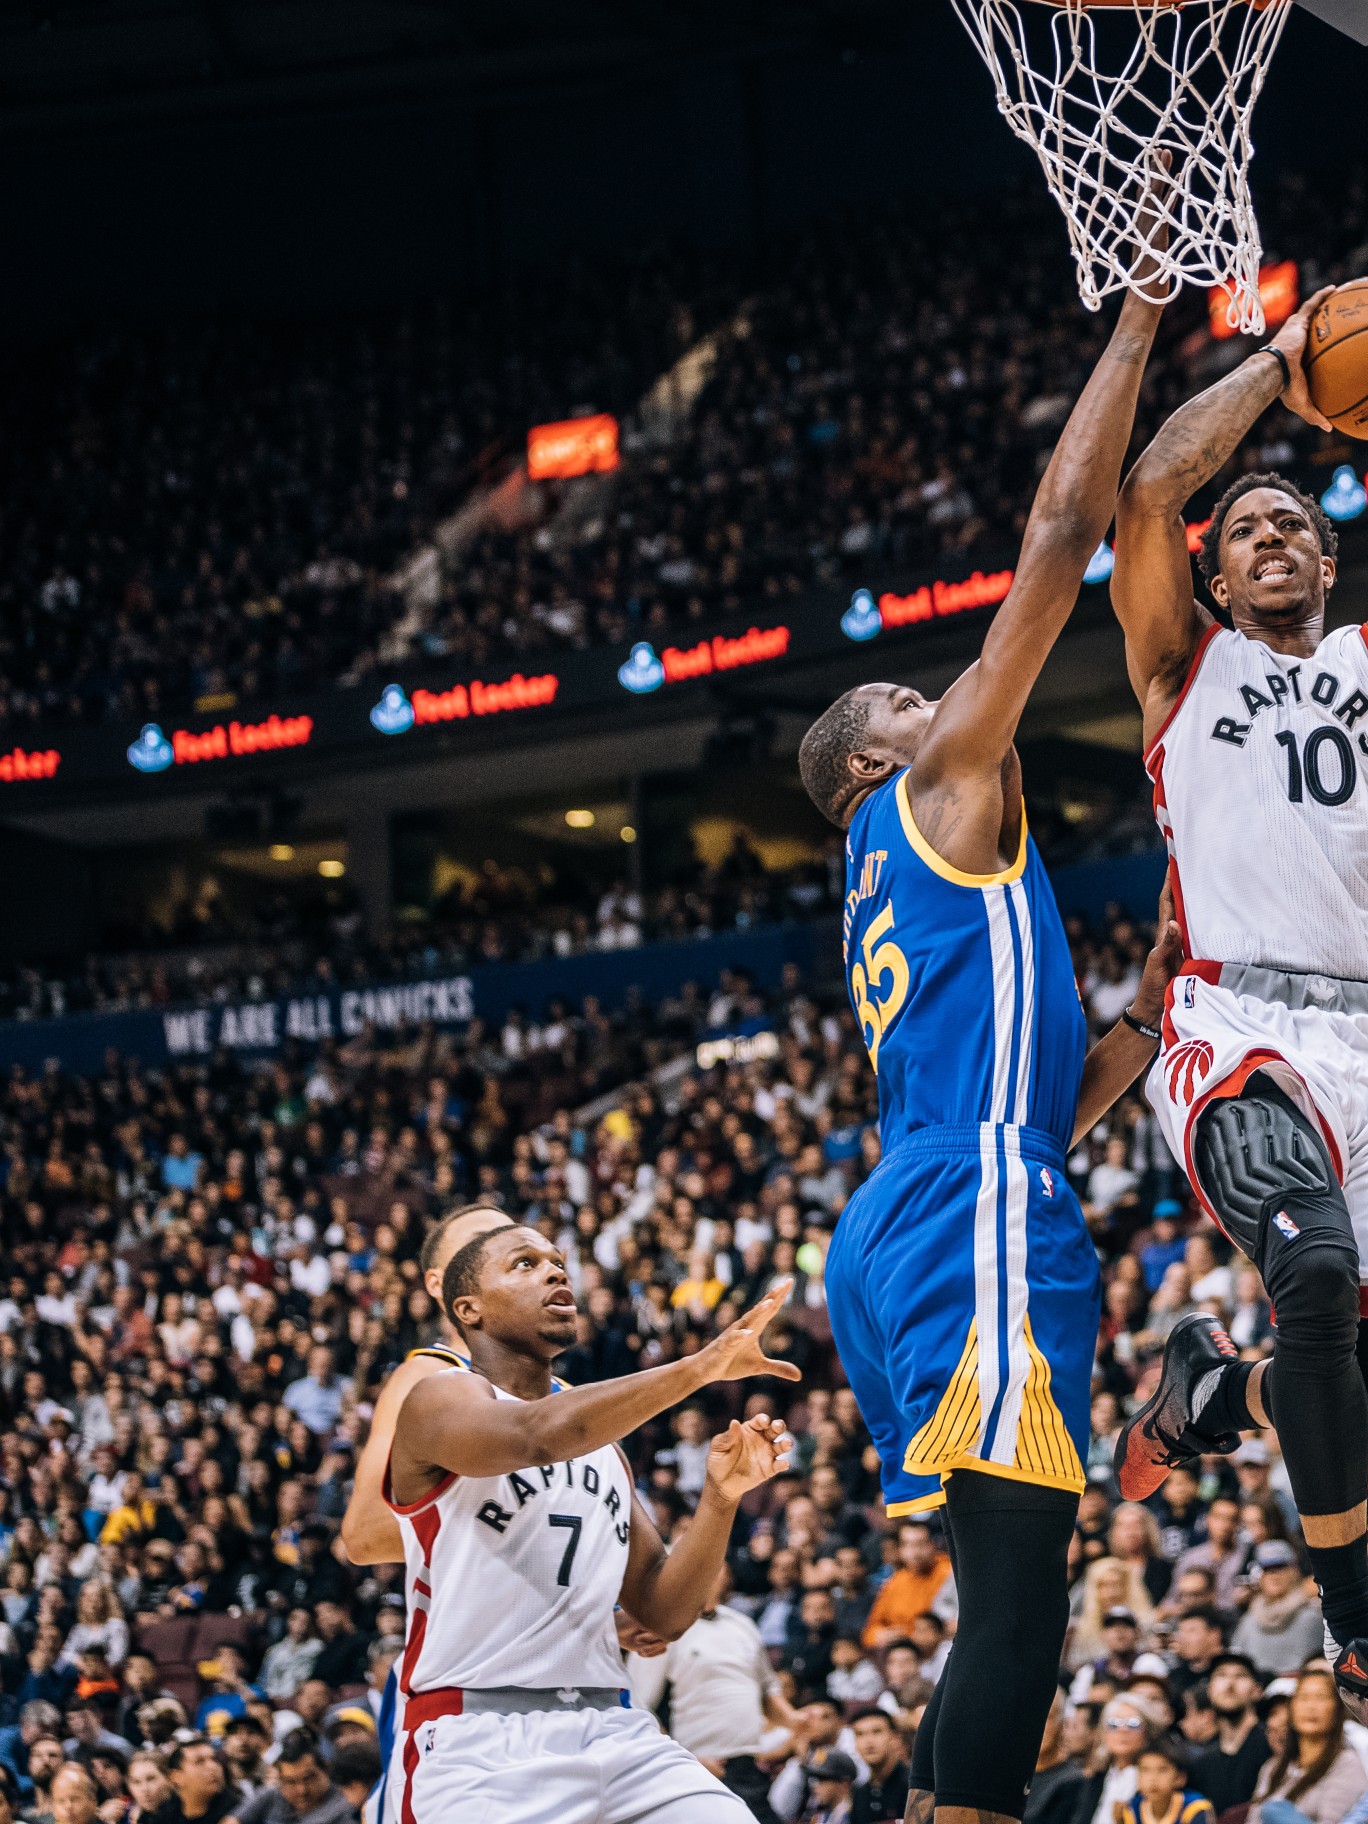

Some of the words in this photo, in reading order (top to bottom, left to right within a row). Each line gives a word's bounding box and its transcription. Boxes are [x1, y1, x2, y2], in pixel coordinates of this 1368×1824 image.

[879, 587, 934, 627] Foot
[712, 627, 789, 670] Locker
[469, 674, 558, 715] Locker
[229, 715, 312, 754] Locker
[1275, 725, 1357, 807] 10
[852, 898, 910, 1076] 35
[162, 1010, 209, 1053] WE
[219, 1003, 277, 1047] ARE
[286, 995, 334, 1041] ALL
[475, 1460, 629, 1546] RAPTORS
[548, 1513, 582, 1587] 7
